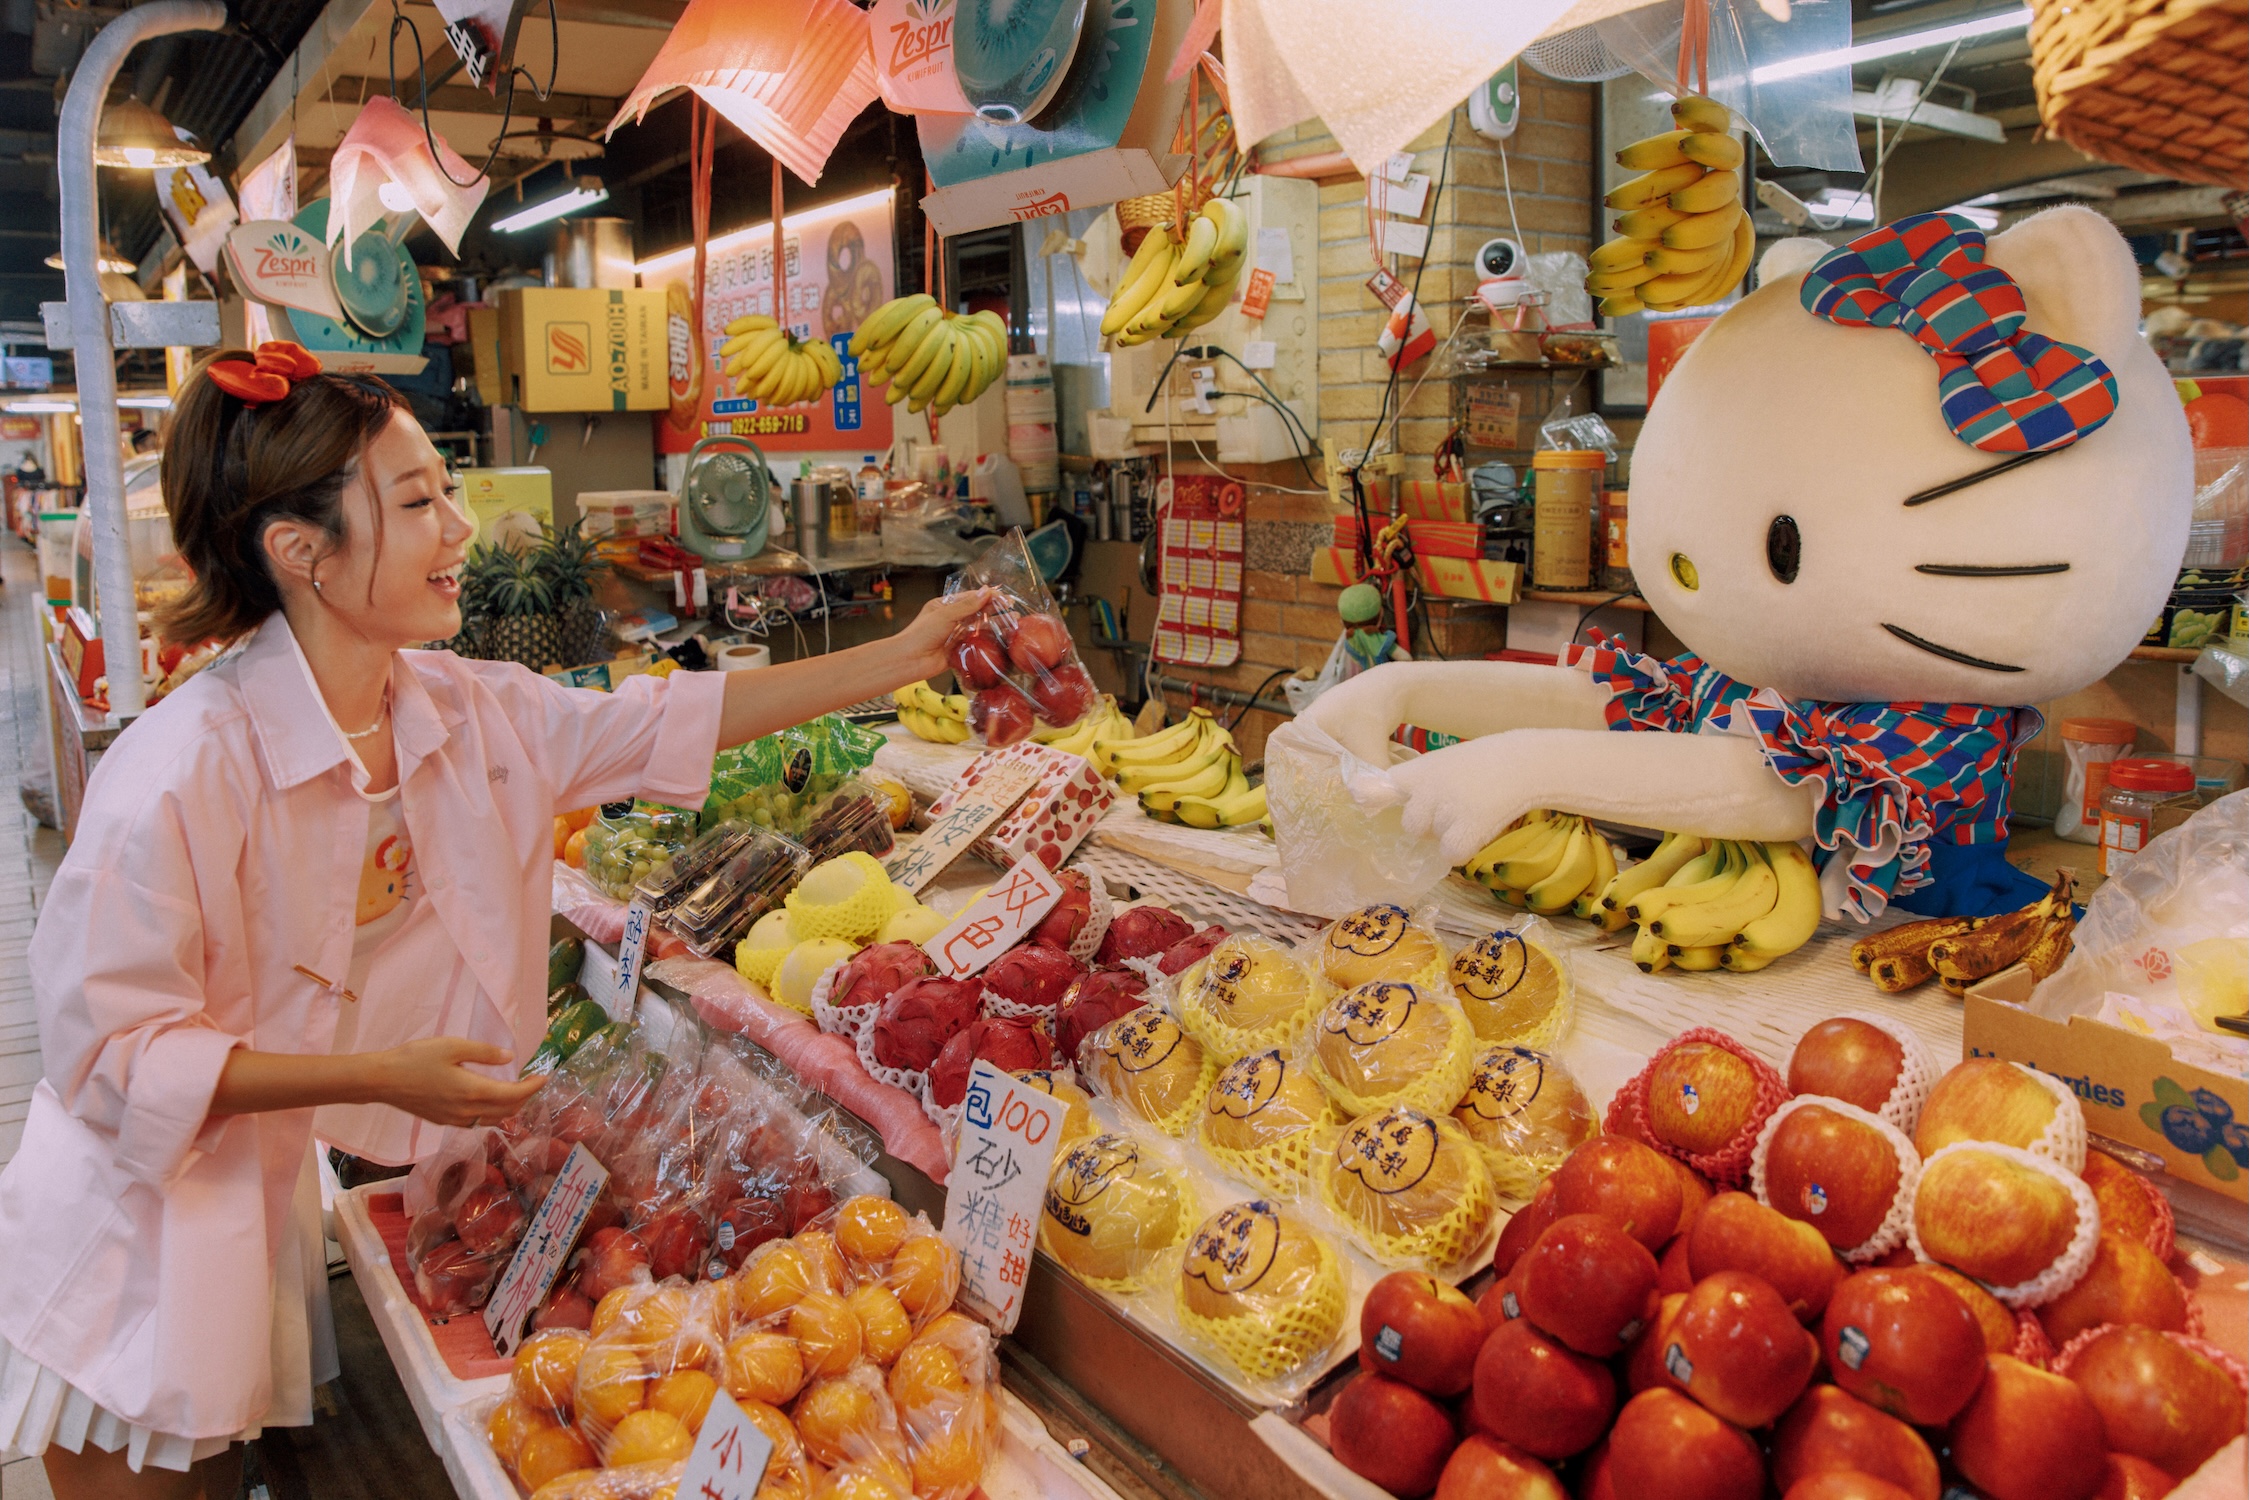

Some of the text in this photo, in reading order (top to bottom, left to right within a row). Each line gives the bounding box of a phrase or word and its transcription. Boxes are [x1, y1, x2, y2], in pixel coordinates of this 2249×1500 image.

[890, 16, 953, 78] Zespr
[907, 61, 944, 83] KIWIFRUIT
[254, 247, 318, 280] Zespri
[1003, 757, 1037, 776] CHERRY
[888, 803, 994, 888] 櫻桃
[966, 1069, 1050, 1145] 一包 100
[500, 1163, 589, 1340] 甜桃
